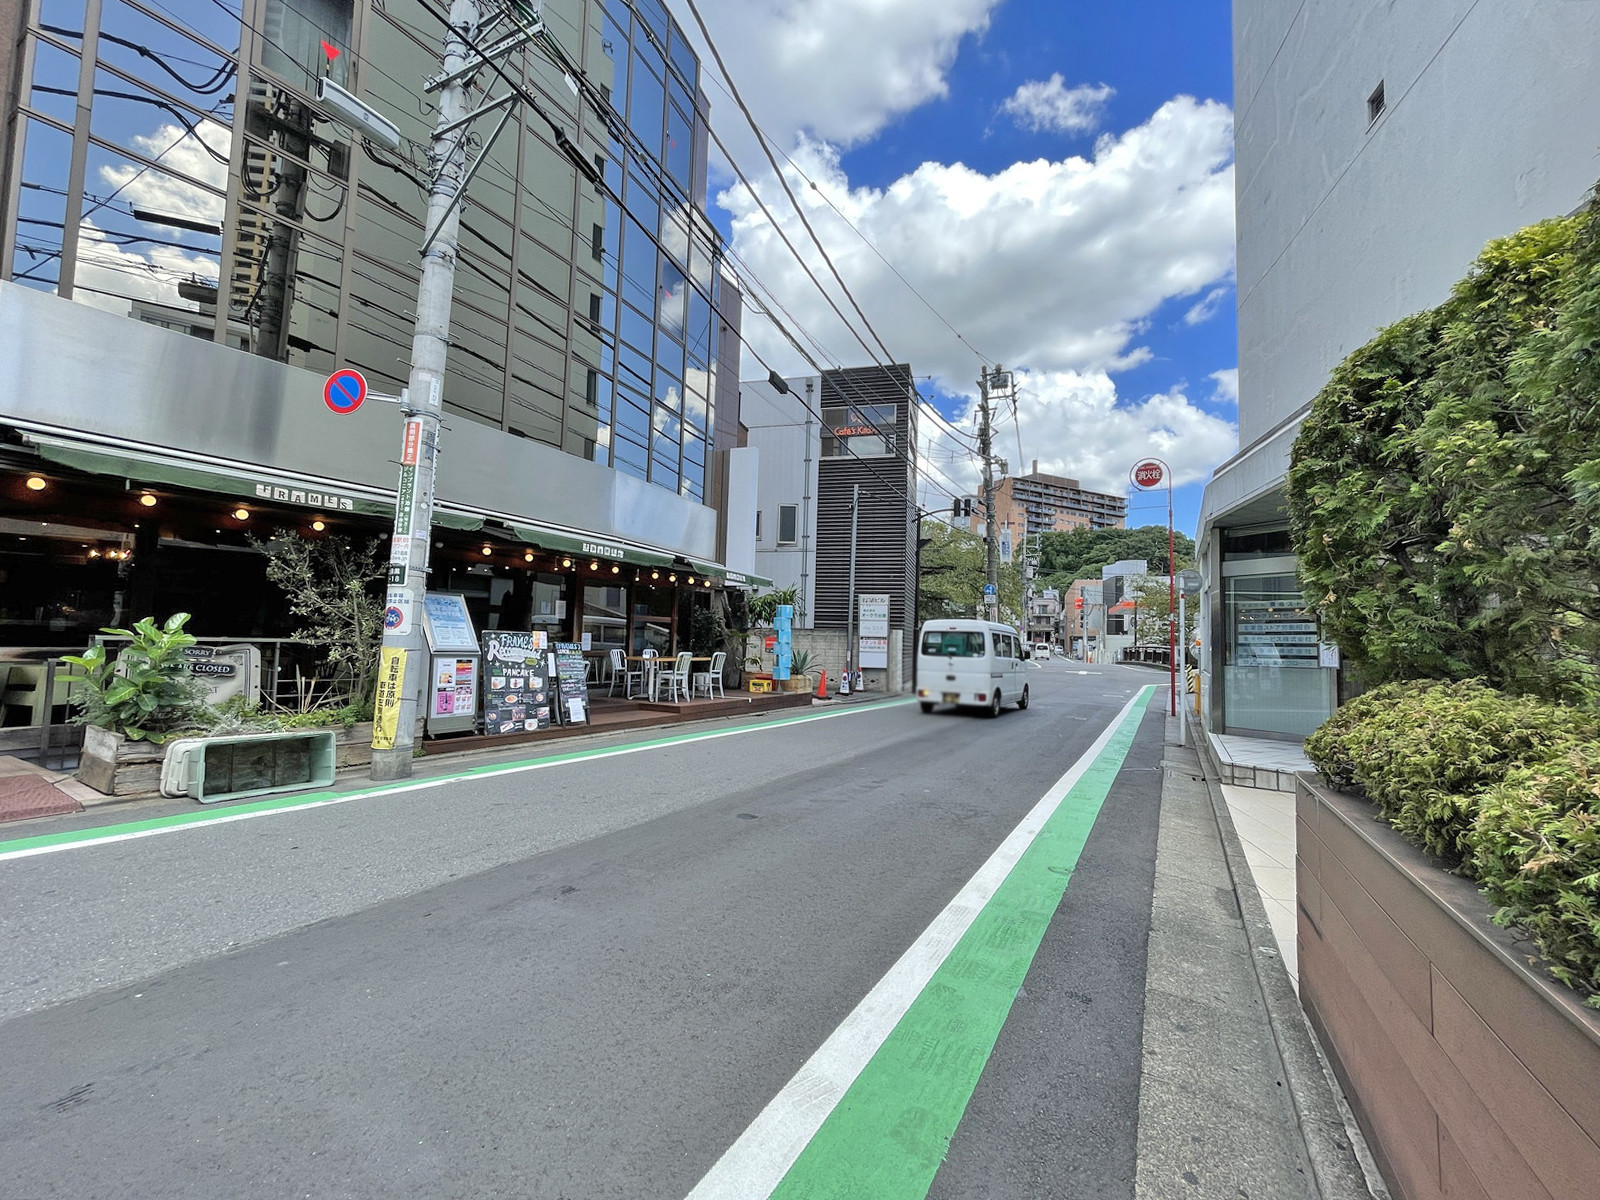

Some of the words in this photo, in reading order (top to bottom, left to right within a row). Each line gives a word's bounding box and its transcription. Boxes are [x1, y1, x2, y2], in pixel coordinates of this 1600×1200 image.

[1137, 469, 1161, 480] 消火栓
[260, 484, 349, 509] FRAMES
[195, 664, 230, 674] CLOSED
[502, 668, 535, 678] PANCAKE
